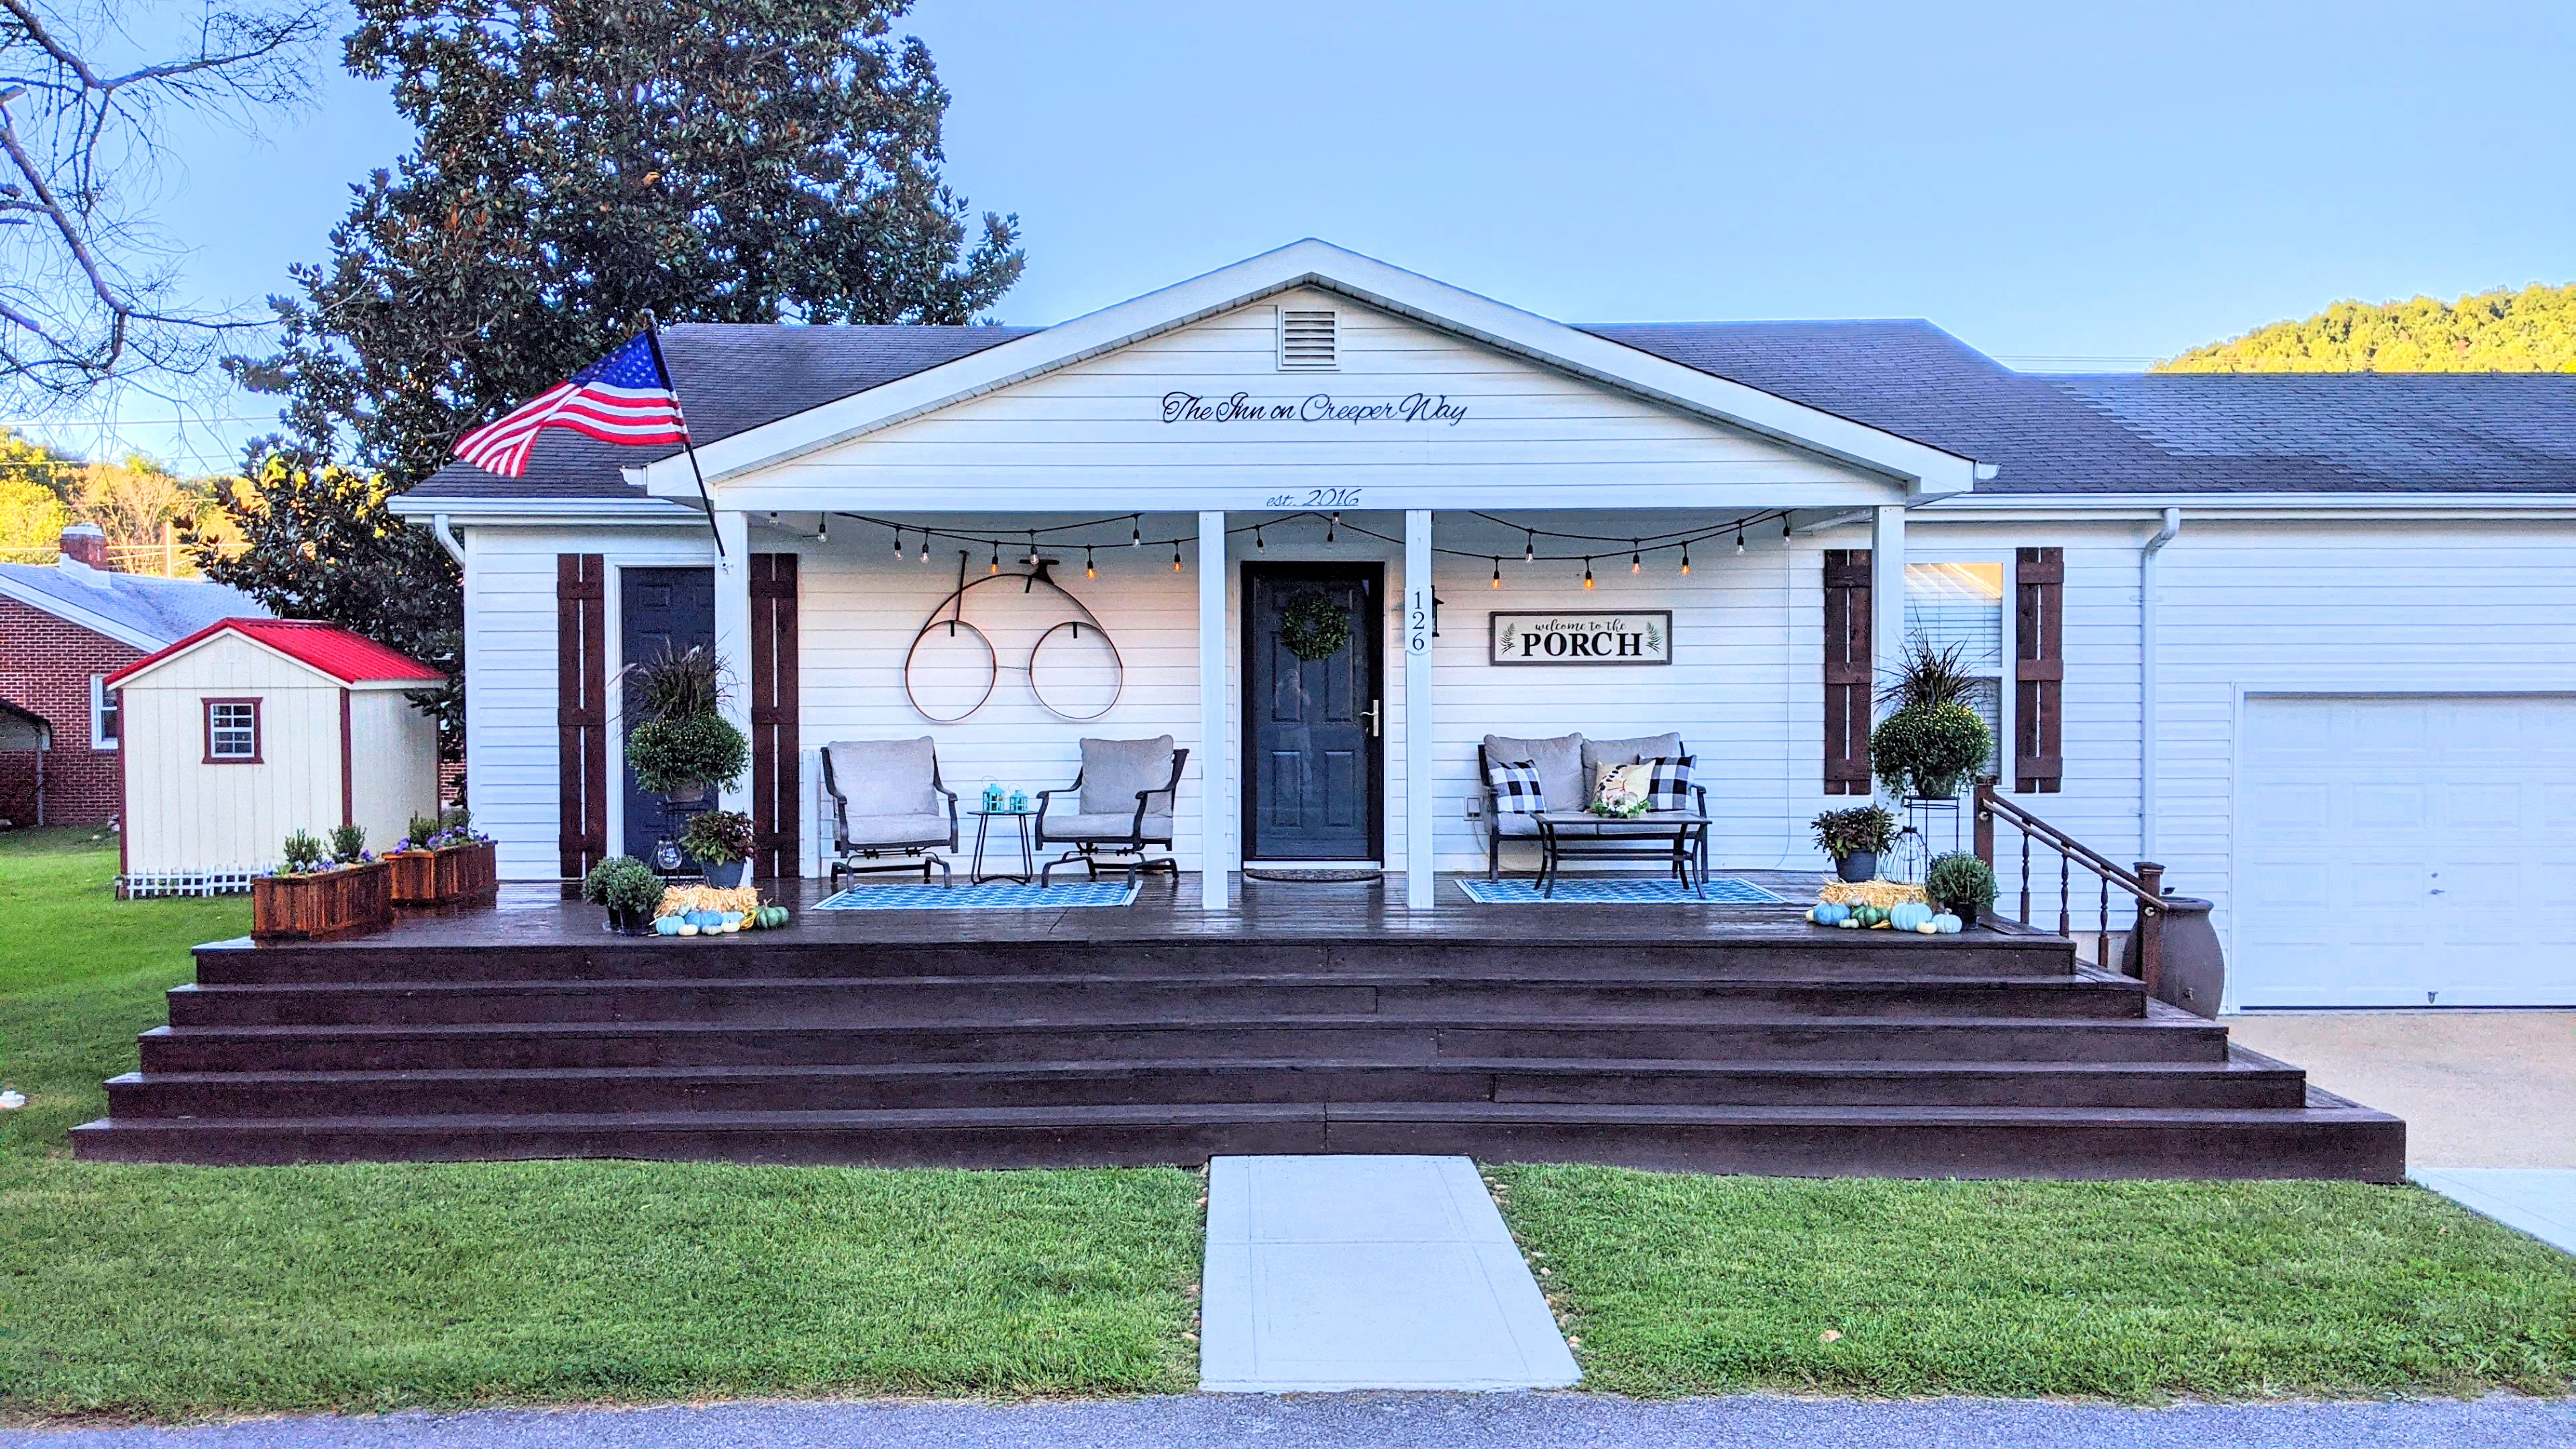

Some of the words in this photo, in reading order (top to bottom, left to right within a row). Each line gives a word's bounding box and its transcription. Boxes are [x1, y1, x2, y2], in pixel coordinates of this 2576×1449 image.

[1163, 392, 1213, 423] The
[1216, 392, 1267, 422] Inn
[1271, 404, 1295, 419] on
[1300, 394, 1399, 425] Creeper
[1399, 393, 1468, 427] Way
[1267, 495, 1296, 507] est.
[1302, 488, 1362, 506] 2016
[1412, 590, 1425, 651] 126
[1536, 619, 1587, 631] welcome
[1590, 621, 1601, 631] to
[1607, 619, 1626, 631] the
[1521, 632, 1643, 657] PORCH
